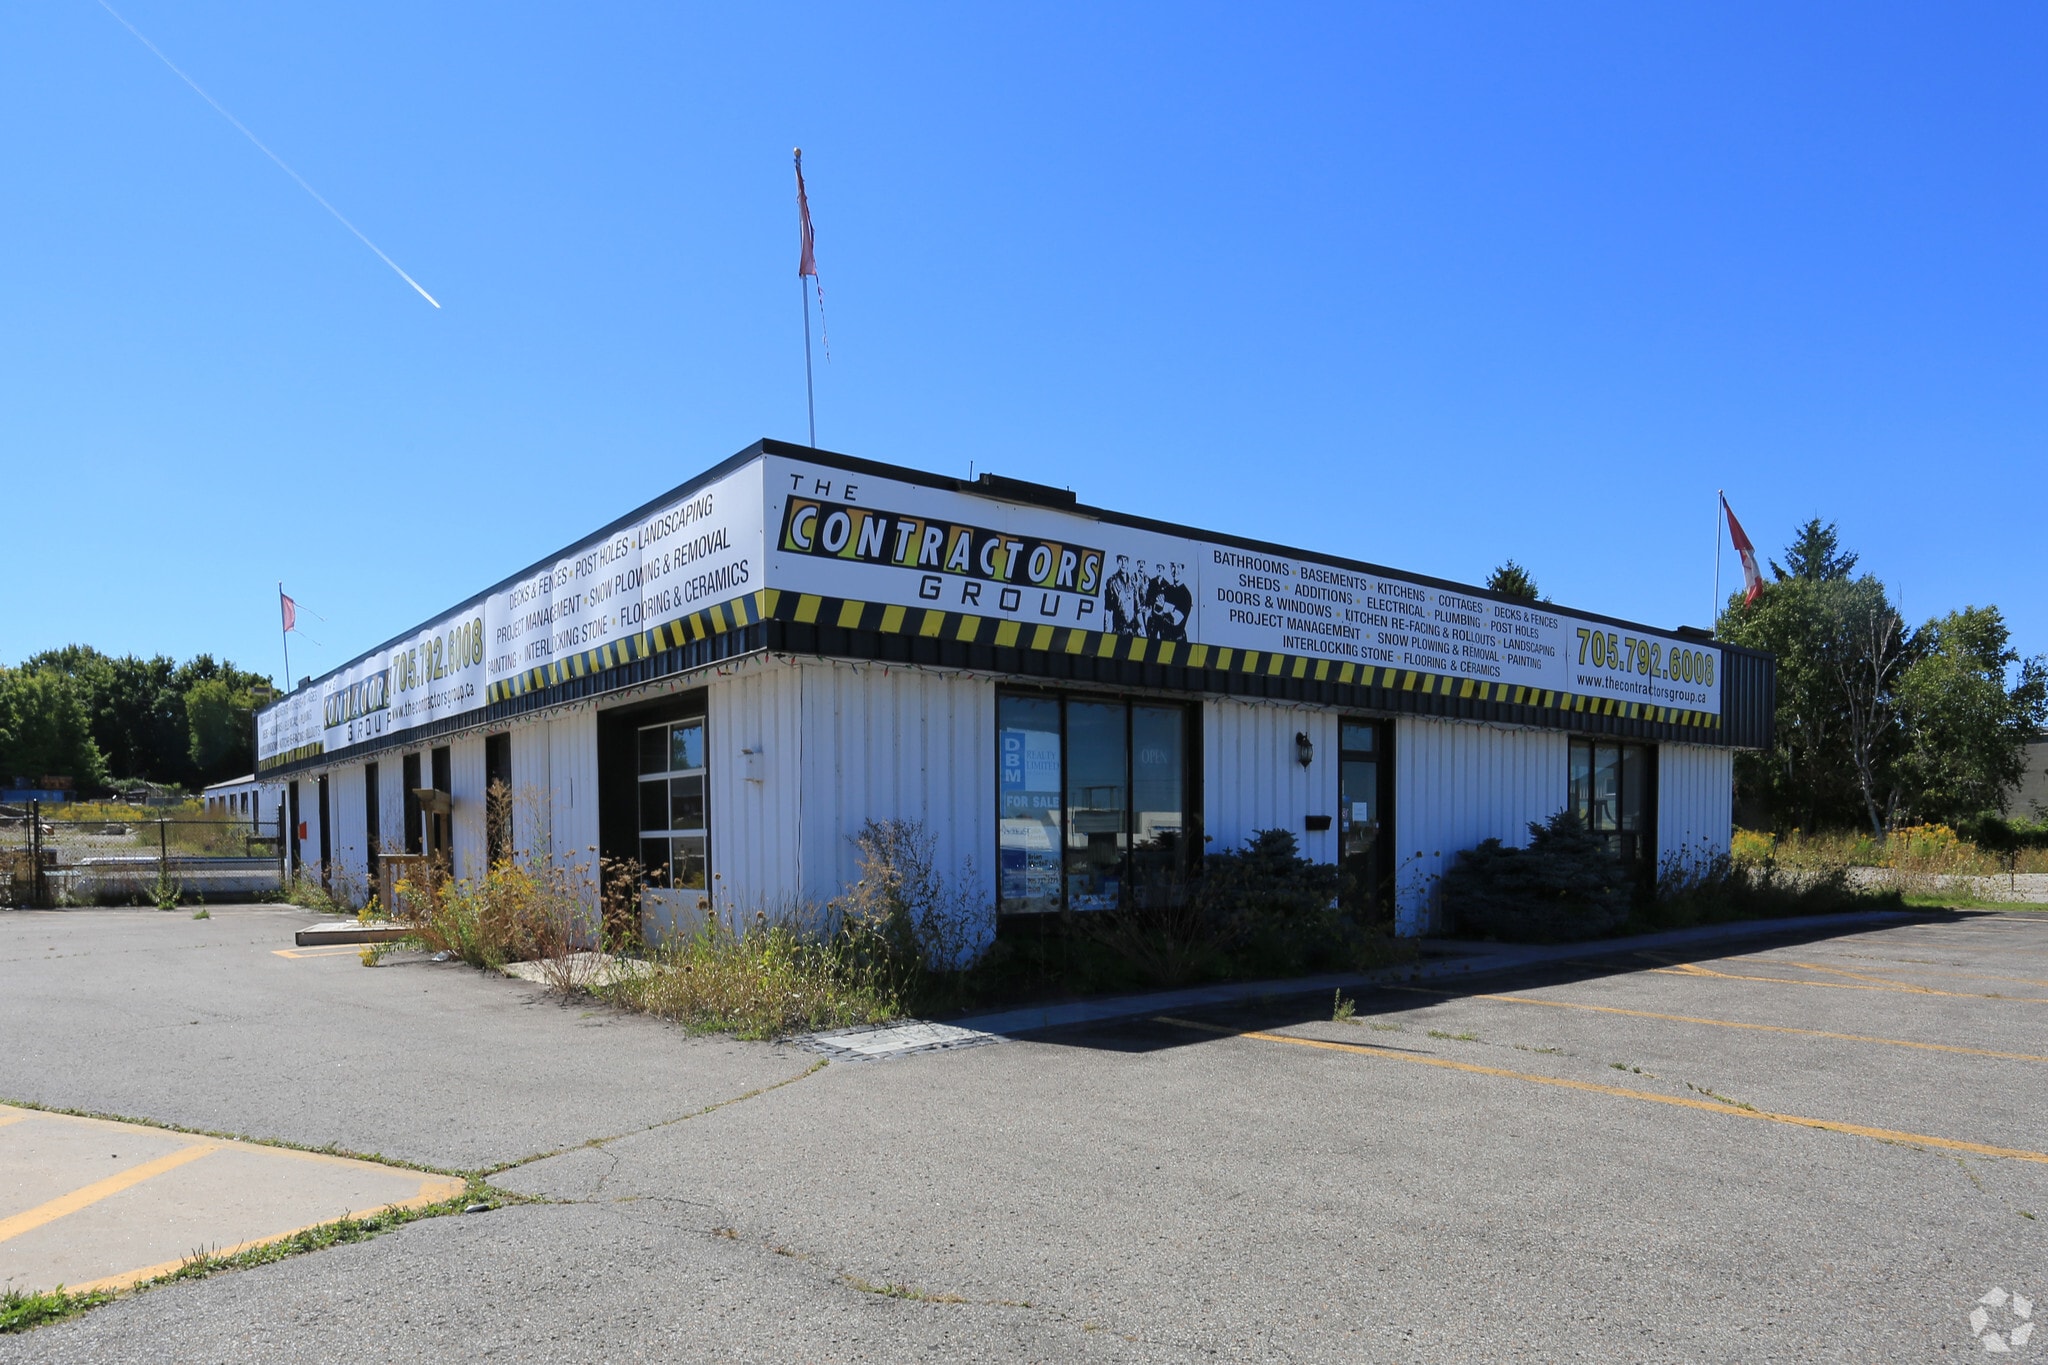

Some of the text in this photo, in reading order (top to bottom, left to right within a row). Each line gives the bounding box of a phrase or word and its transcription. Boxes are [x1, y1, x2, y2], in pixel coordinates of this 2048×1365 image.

[790, 473, 858, 501] THE
[538, 566, 568, 598] FENCES
[576, 553, 598, 579] POST
[600, 536, 628, 568] HOLES
[638, 493, 713, 550] LANDSCAPING
[790, 504, 1100, 592] CONTRACTORS
[497, 527, 731, 644] PROJECT MANAGEMENT SNOW PLOWING & REMOVAL
[582, 615, 608, 642] STONE
[621, 590, 670, 628] FLOORING
[673, 586, 682, 608] &
[684, 559, 749, 603] CERAMICS
[919, 575, 1094, 620] GROUP
[1213, 550, 1558, 629] BATHROOMS BASEMENTS KITCHENS COTTAGES DECKS & FENCES
[1239, 574, 1539, 639] SHEDS ADDITIONS ELECTRICAL PLUMBING POST HOLES
[1217, 588, 1555, 657] DOORS & WINDOWS KITCHEN RE-FACING & ROLLOUTS LANDSCAPING
[1230, 609, 1542, 670] PROJECT MANAGEMENT SNOW PLOWING & REMOVAL PAINTING
[1283, 635, 1501, 677] INTERLOCKING STONE FLOORING & CERAMICS
[1576, 627, 1715, 687] 705.792.6008
[1577, 674, 1706, 704] www.thecontractorsgroup.ca
[348, 711, 391, 741] GROUP
[1141, 748, 1168, 764] OPEN
[1006, 795, 1059, 809] FOR SALE
